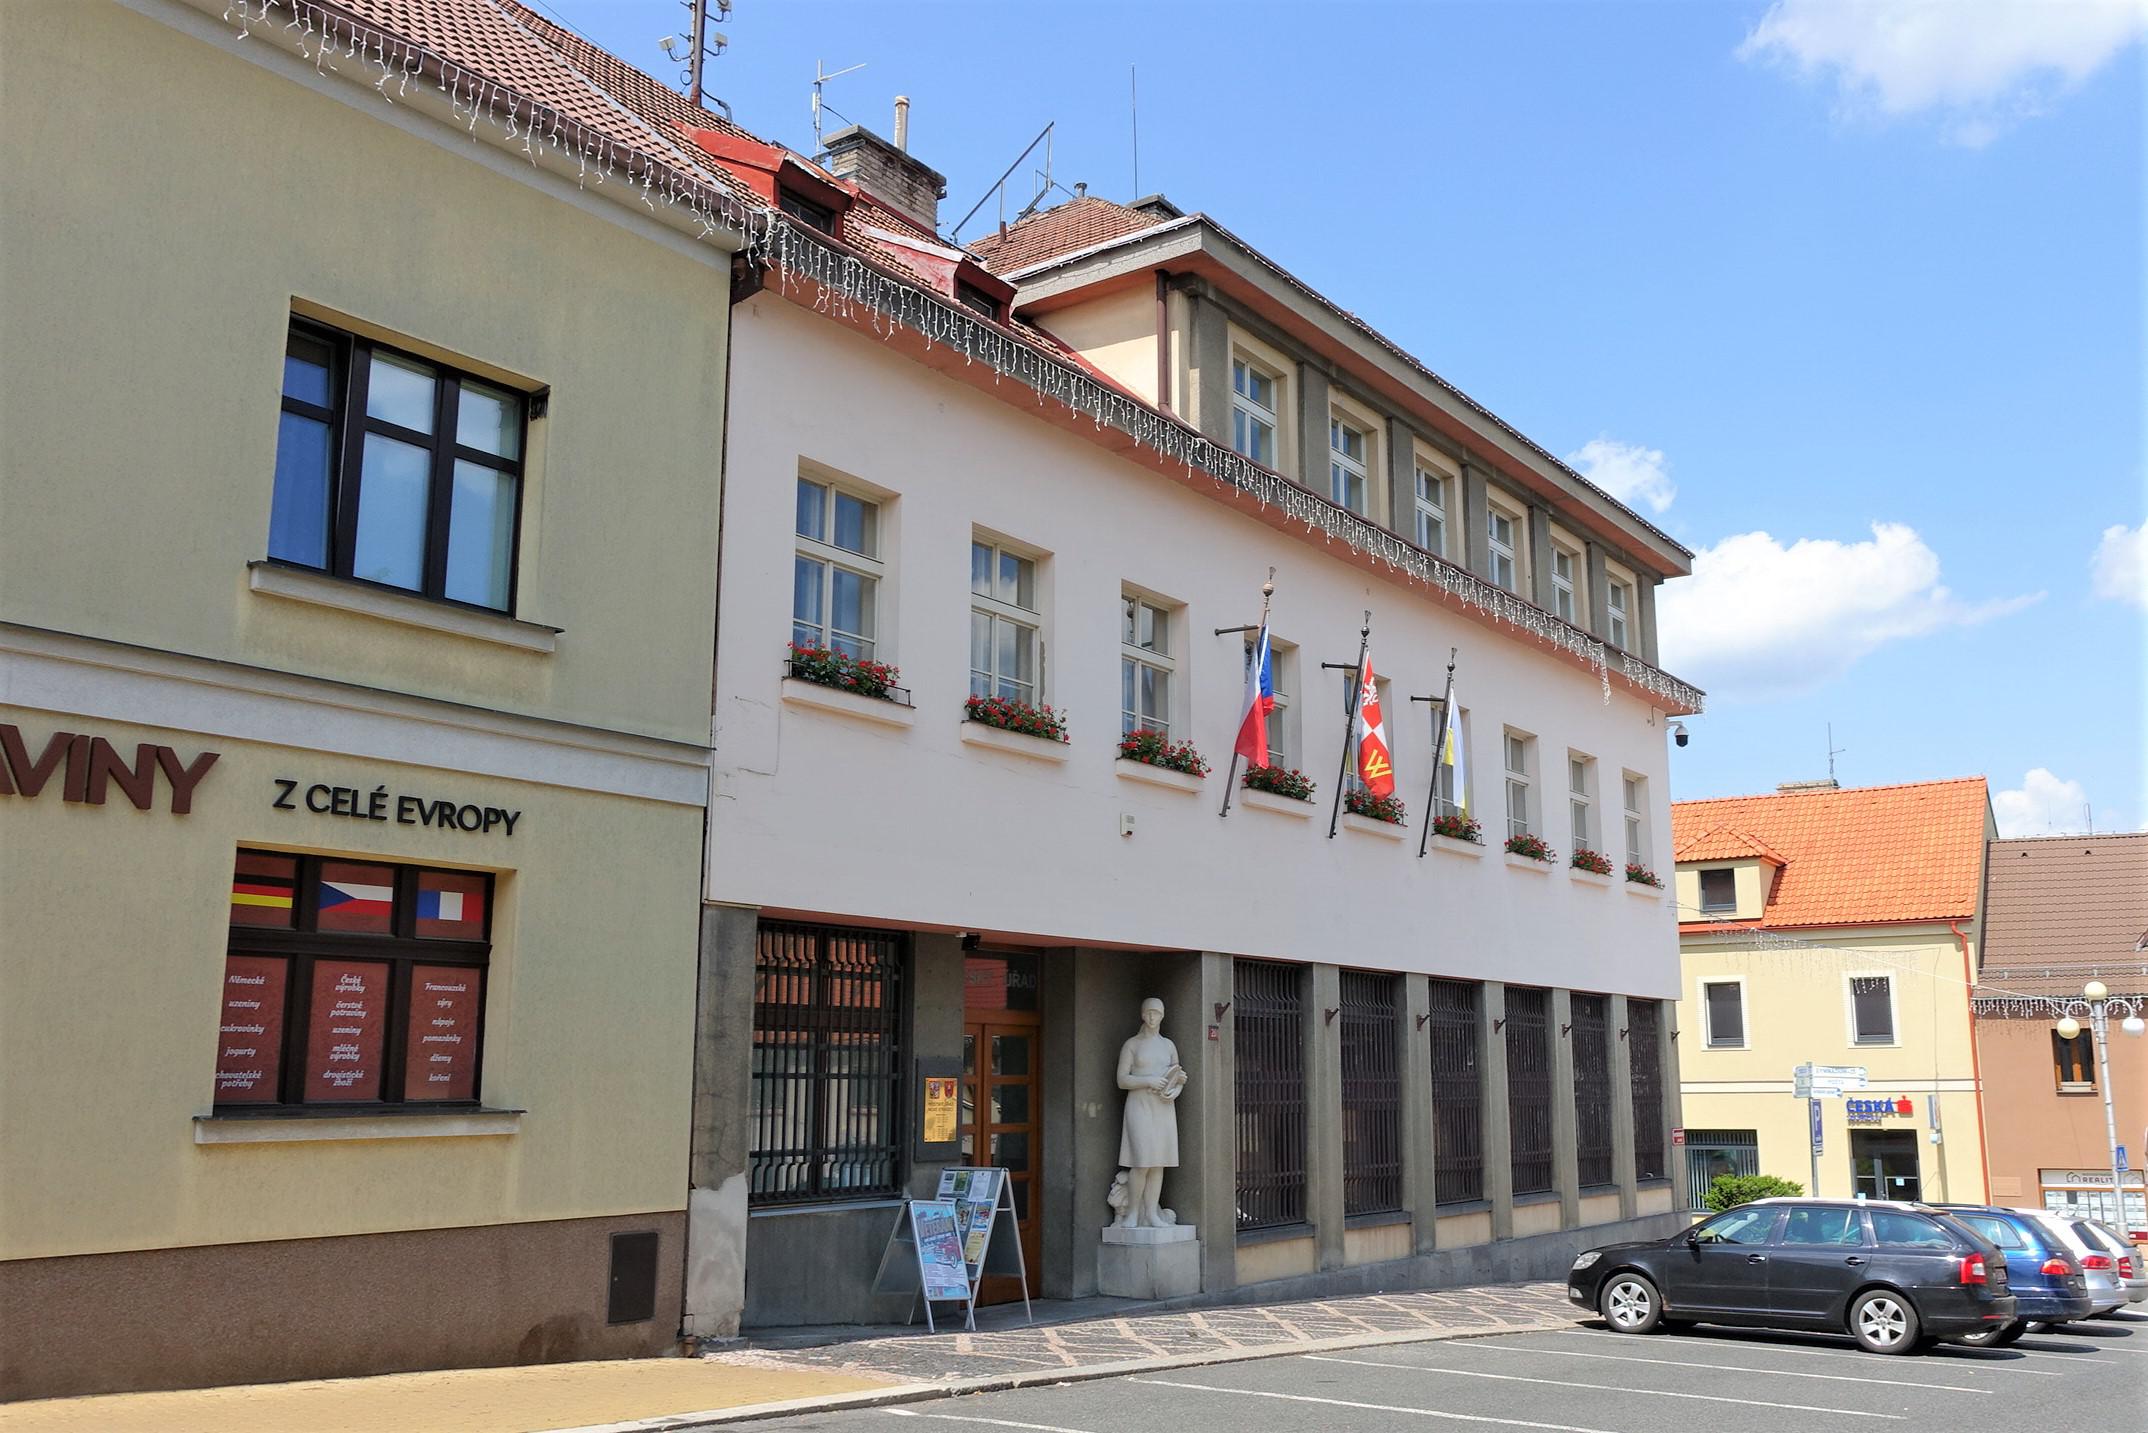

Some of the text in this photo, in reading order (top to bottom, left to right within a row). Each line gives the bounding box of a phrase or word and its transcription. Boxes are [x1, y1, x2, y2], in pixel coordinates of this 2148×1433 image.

[273, 779, 522, 836] Z CELÉ EVROPY
[335, 982, 365, 994] výrobky
[228, 999, 261, 1010] uzeniny
[329, 1008, 367, 1018] potraviny
[431, 1017, 456, 1027] nápoje
[331, 1025, 362, 1036] uzeniny
[224, 1046, 257, 1057] jogurty
[329, 1051, 361, 1062] výrobky
[220, 1079, 254, 1090] potřeby
[1846, 1097, 1895, 1113] ČESKÁ
